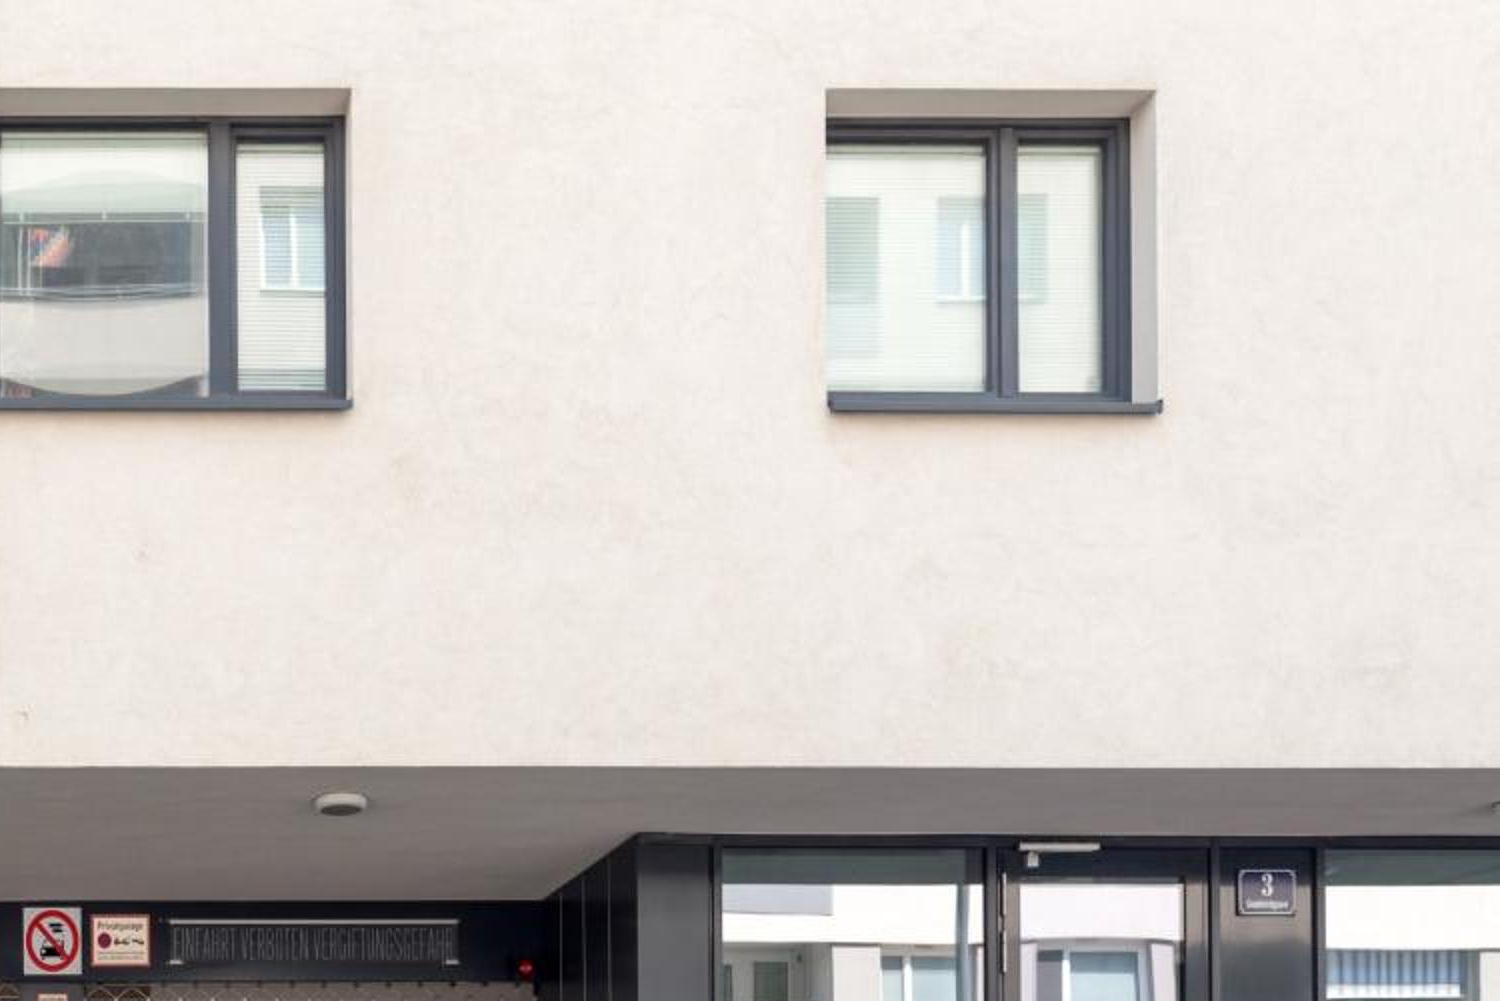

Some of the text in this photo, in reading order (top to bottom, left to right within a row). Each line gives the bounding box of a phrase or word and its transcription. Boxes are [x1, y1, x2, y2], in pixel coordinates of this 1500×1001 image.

[1260, 872, 1274, 897] 3
[173, 927, 453, 960] EINFAHRT VERBOTEN VERGIFTUNGSGEFAHR
